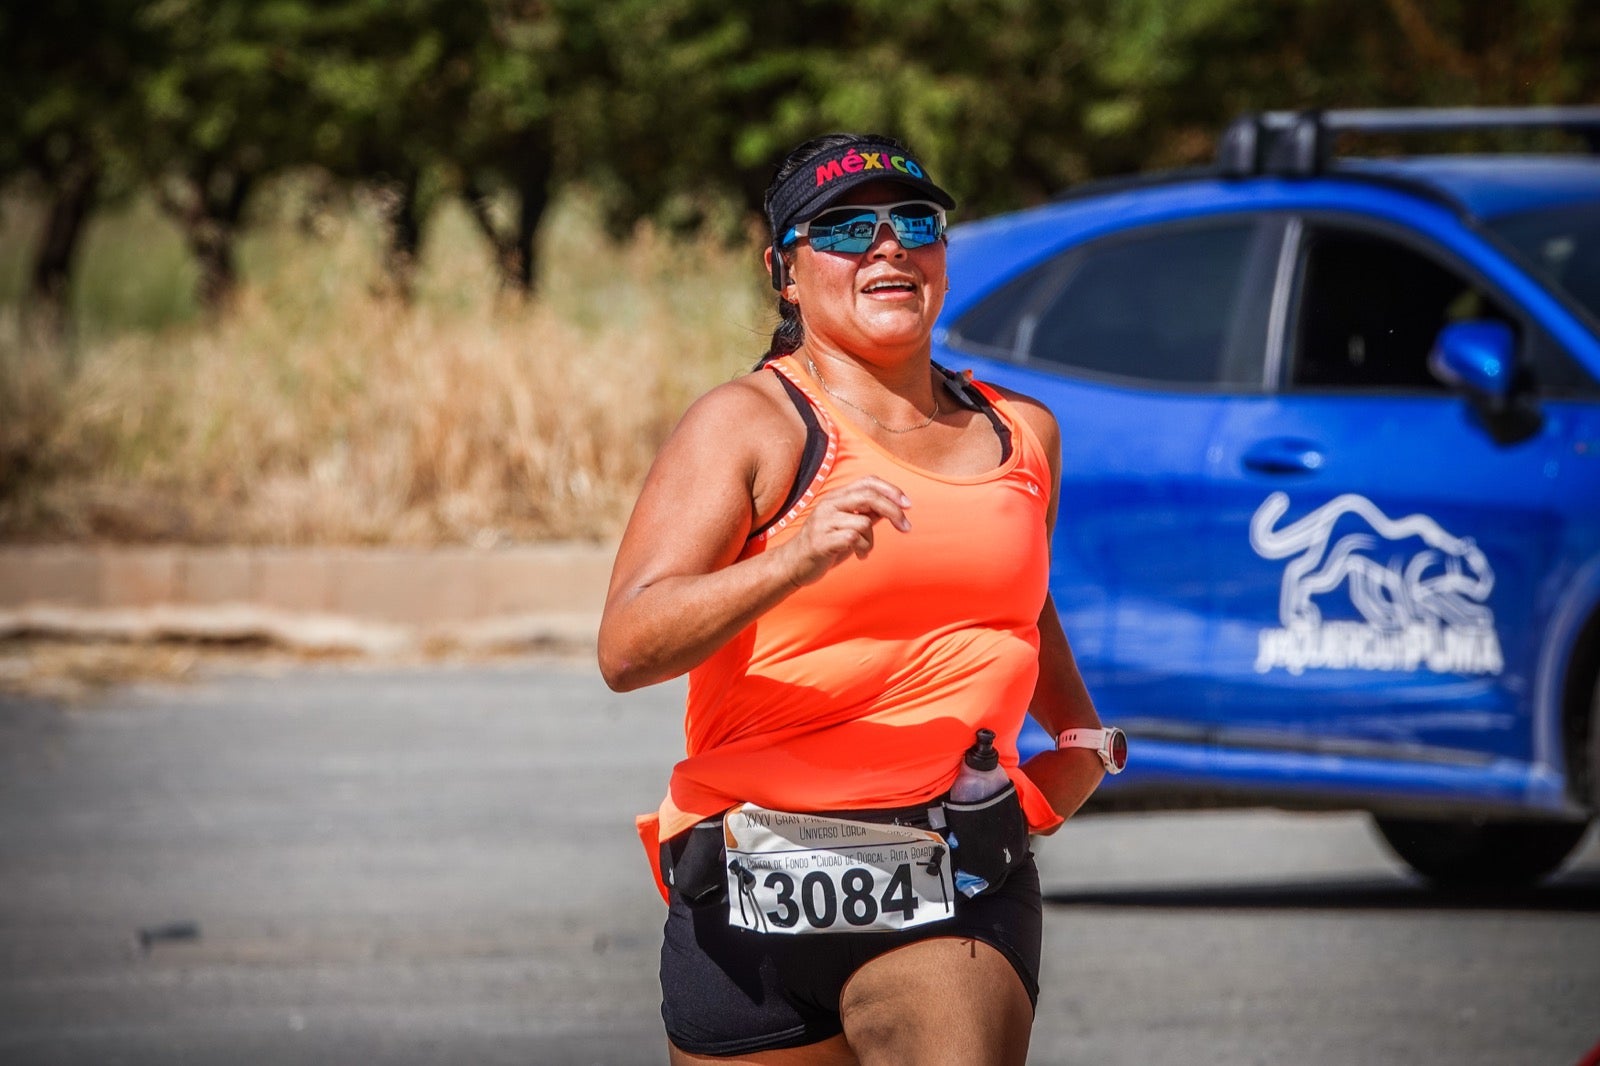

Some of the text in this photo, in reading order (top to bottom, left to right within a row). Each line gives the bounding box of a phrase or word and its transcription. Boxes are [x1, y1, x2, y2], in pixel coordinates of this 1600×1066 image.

[758, 489, 815, 542] ARMOUR
[745, 812, 771, 828] XXXV
[774, 814, 800, 826] GRAN
[799, 824, 867, 841] UNIVERSO LORCA
[785, 857, 809, 870] FONDO
[845, 854, 854, 866] DE
[890, 848, 909, 862] RUTA
[763, 863, 919, 929] 3084
